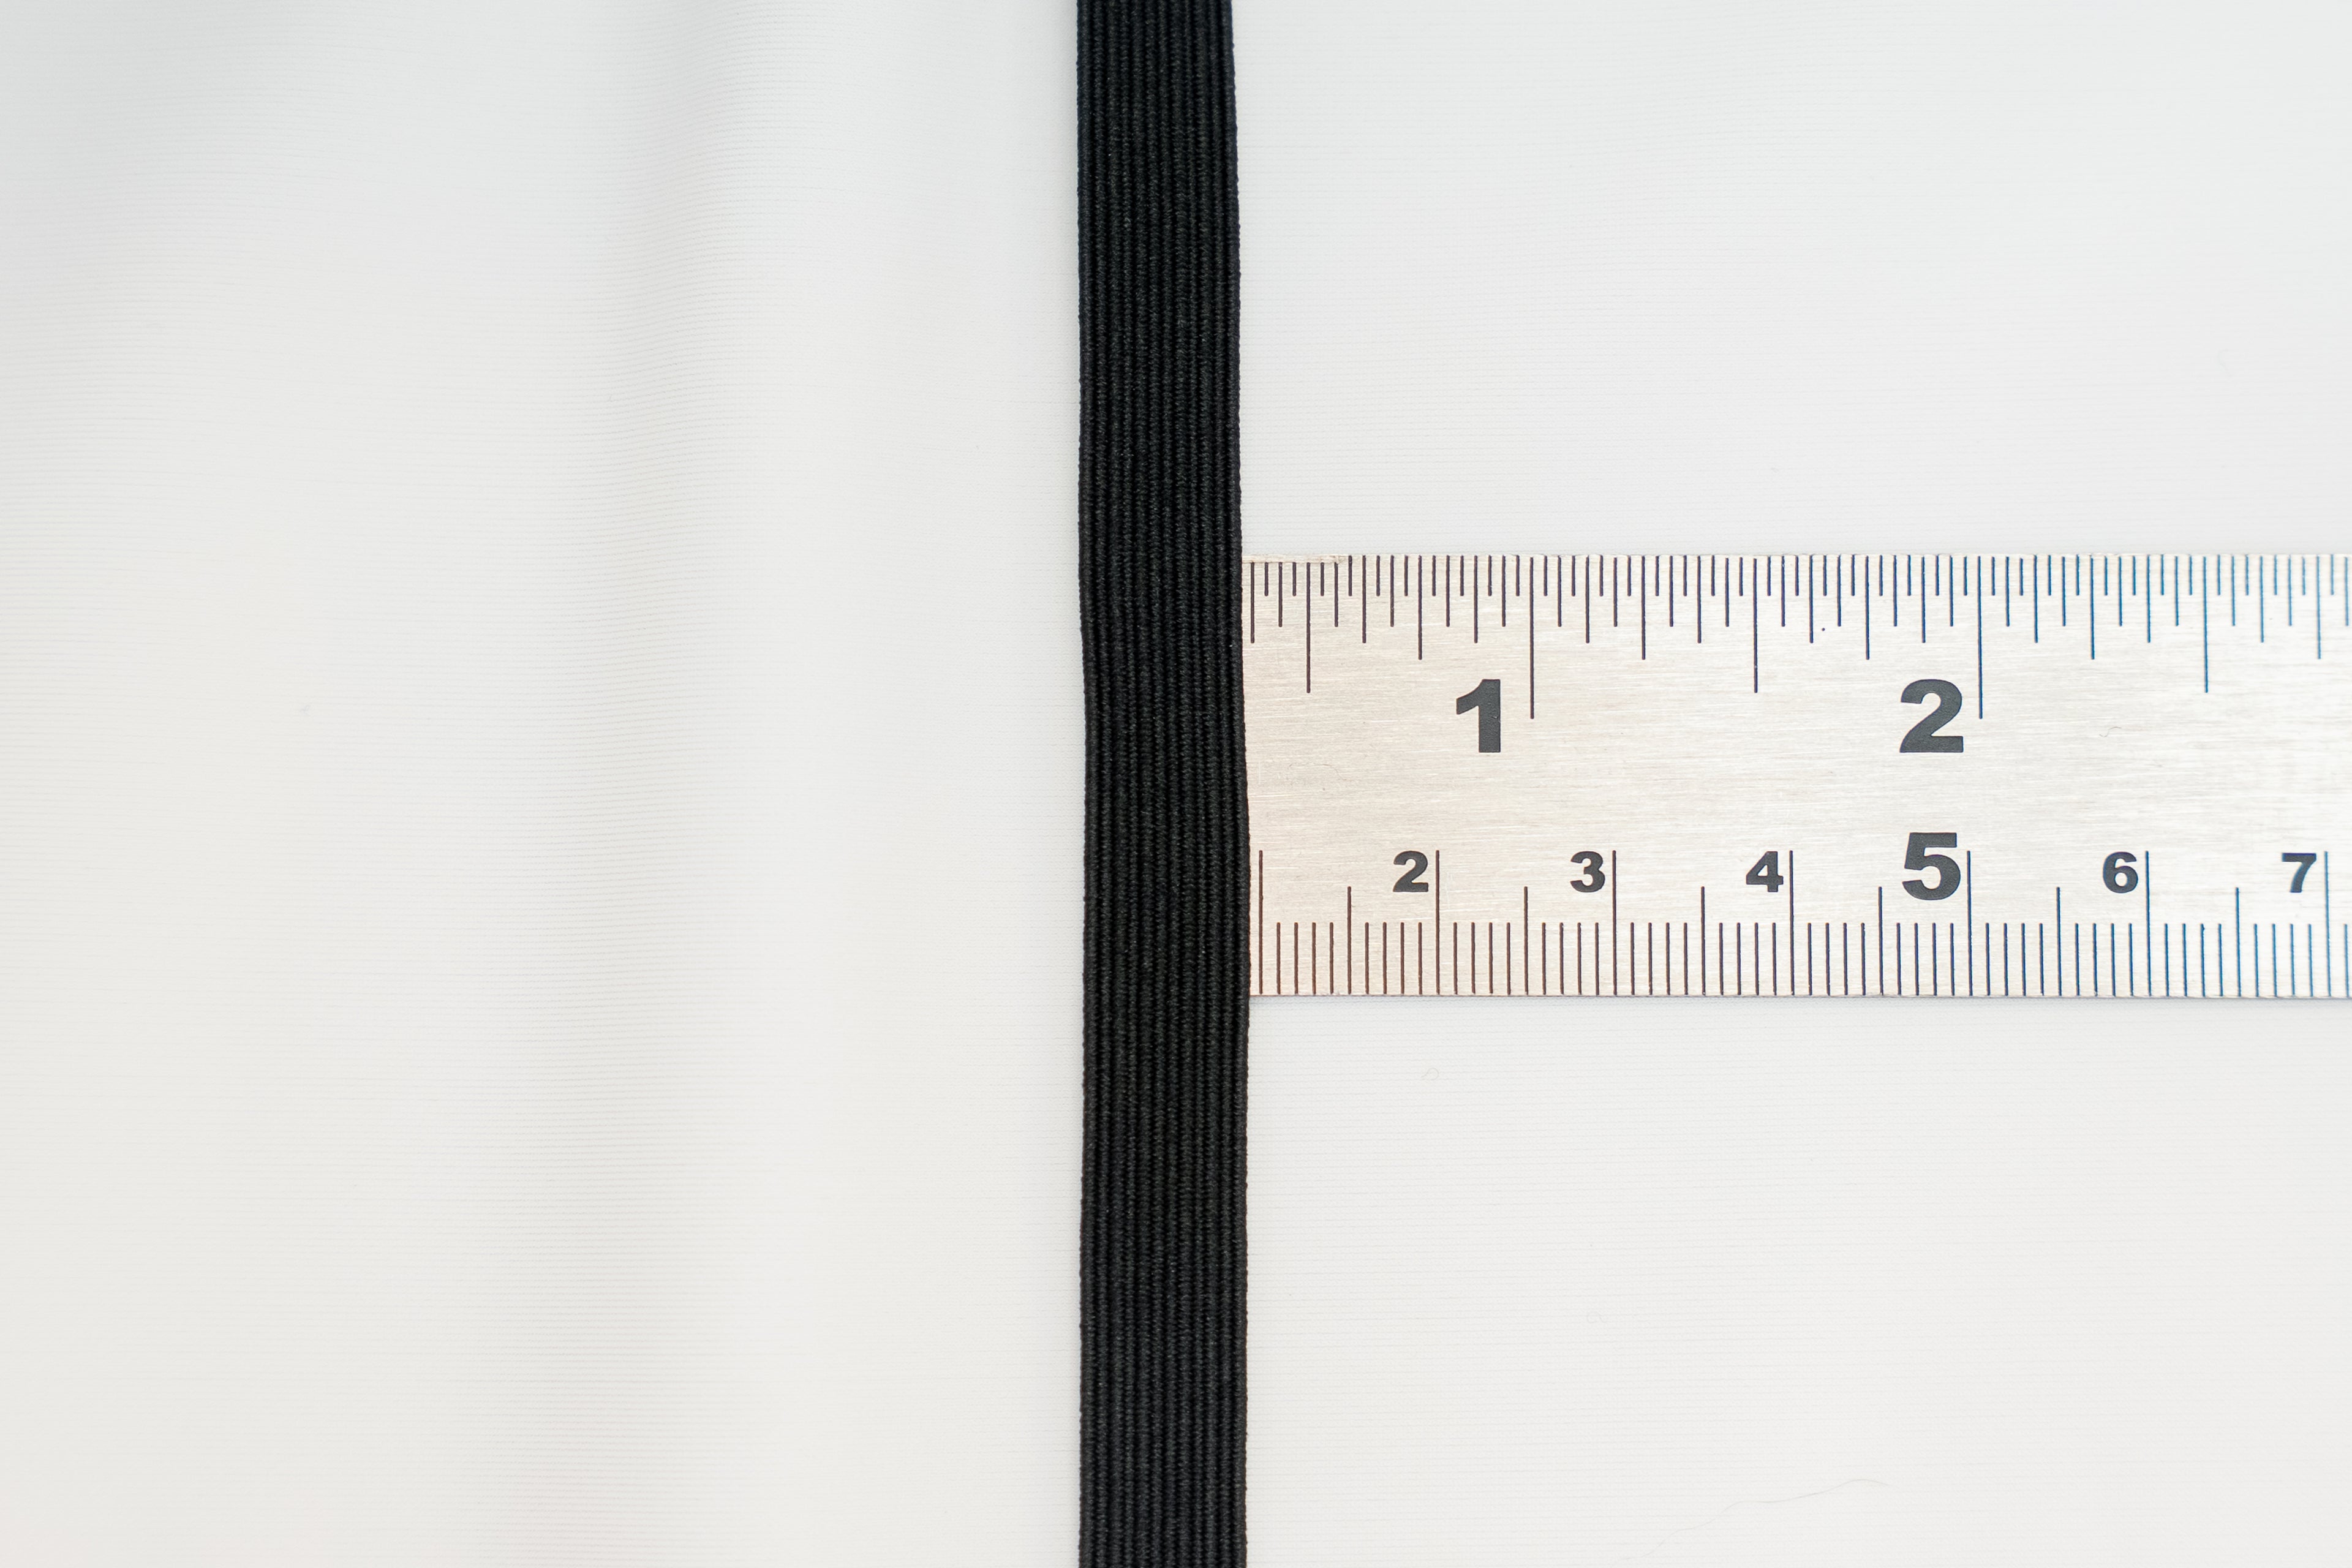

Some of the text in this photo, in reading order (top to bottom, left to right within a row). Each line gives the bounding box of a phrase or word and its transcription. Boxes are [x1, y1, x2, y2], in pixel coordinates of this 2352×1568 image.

[1456, 679, 1964, 753] 1 2
[1393, 832, 2317, 900] 2 3 4 5 6 7
